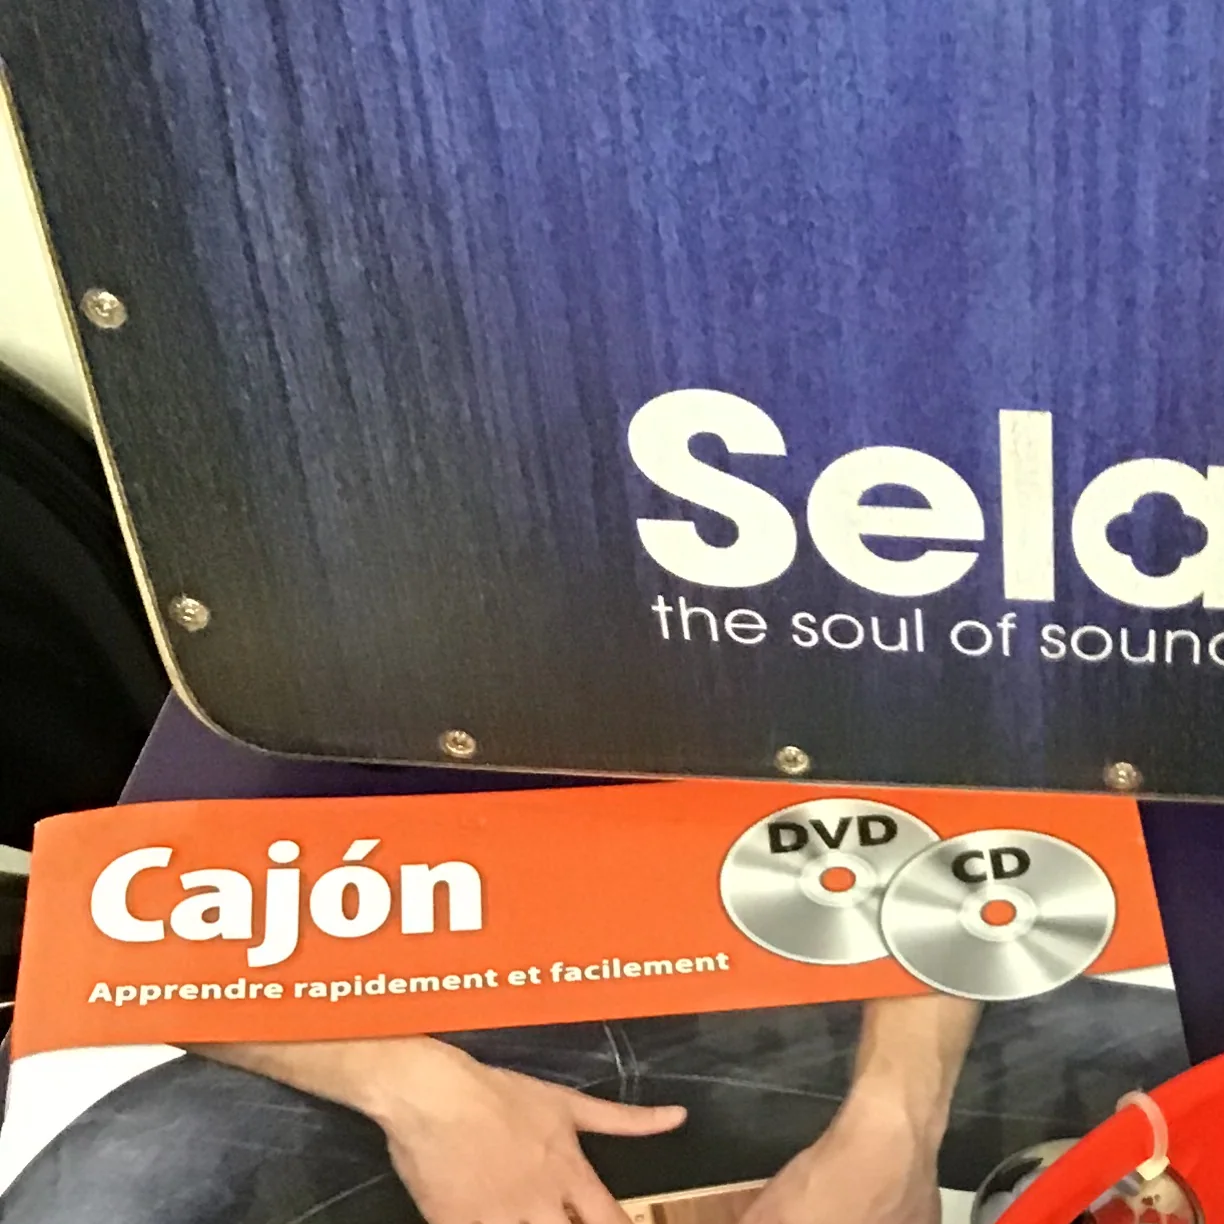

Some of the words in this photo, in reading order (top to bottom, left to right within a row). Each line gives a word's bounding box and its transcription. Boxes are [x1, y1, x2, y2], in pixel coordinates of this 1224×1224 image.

[652, 595, 768, 645] the
[791, 610, 926, 653] soul
[950, 613, 1018, 658] of
[767, 814, 898, 854] DVD
[951, 846, 1031, 883] CD
[90, 838, 484, 968] Cajón
[88, 970, 285, 1007] Apprendre
[294, 968, 499, 1003] rapidement
[507, 965, 542, 987] et
[549, 951, 730, 984] facilement
